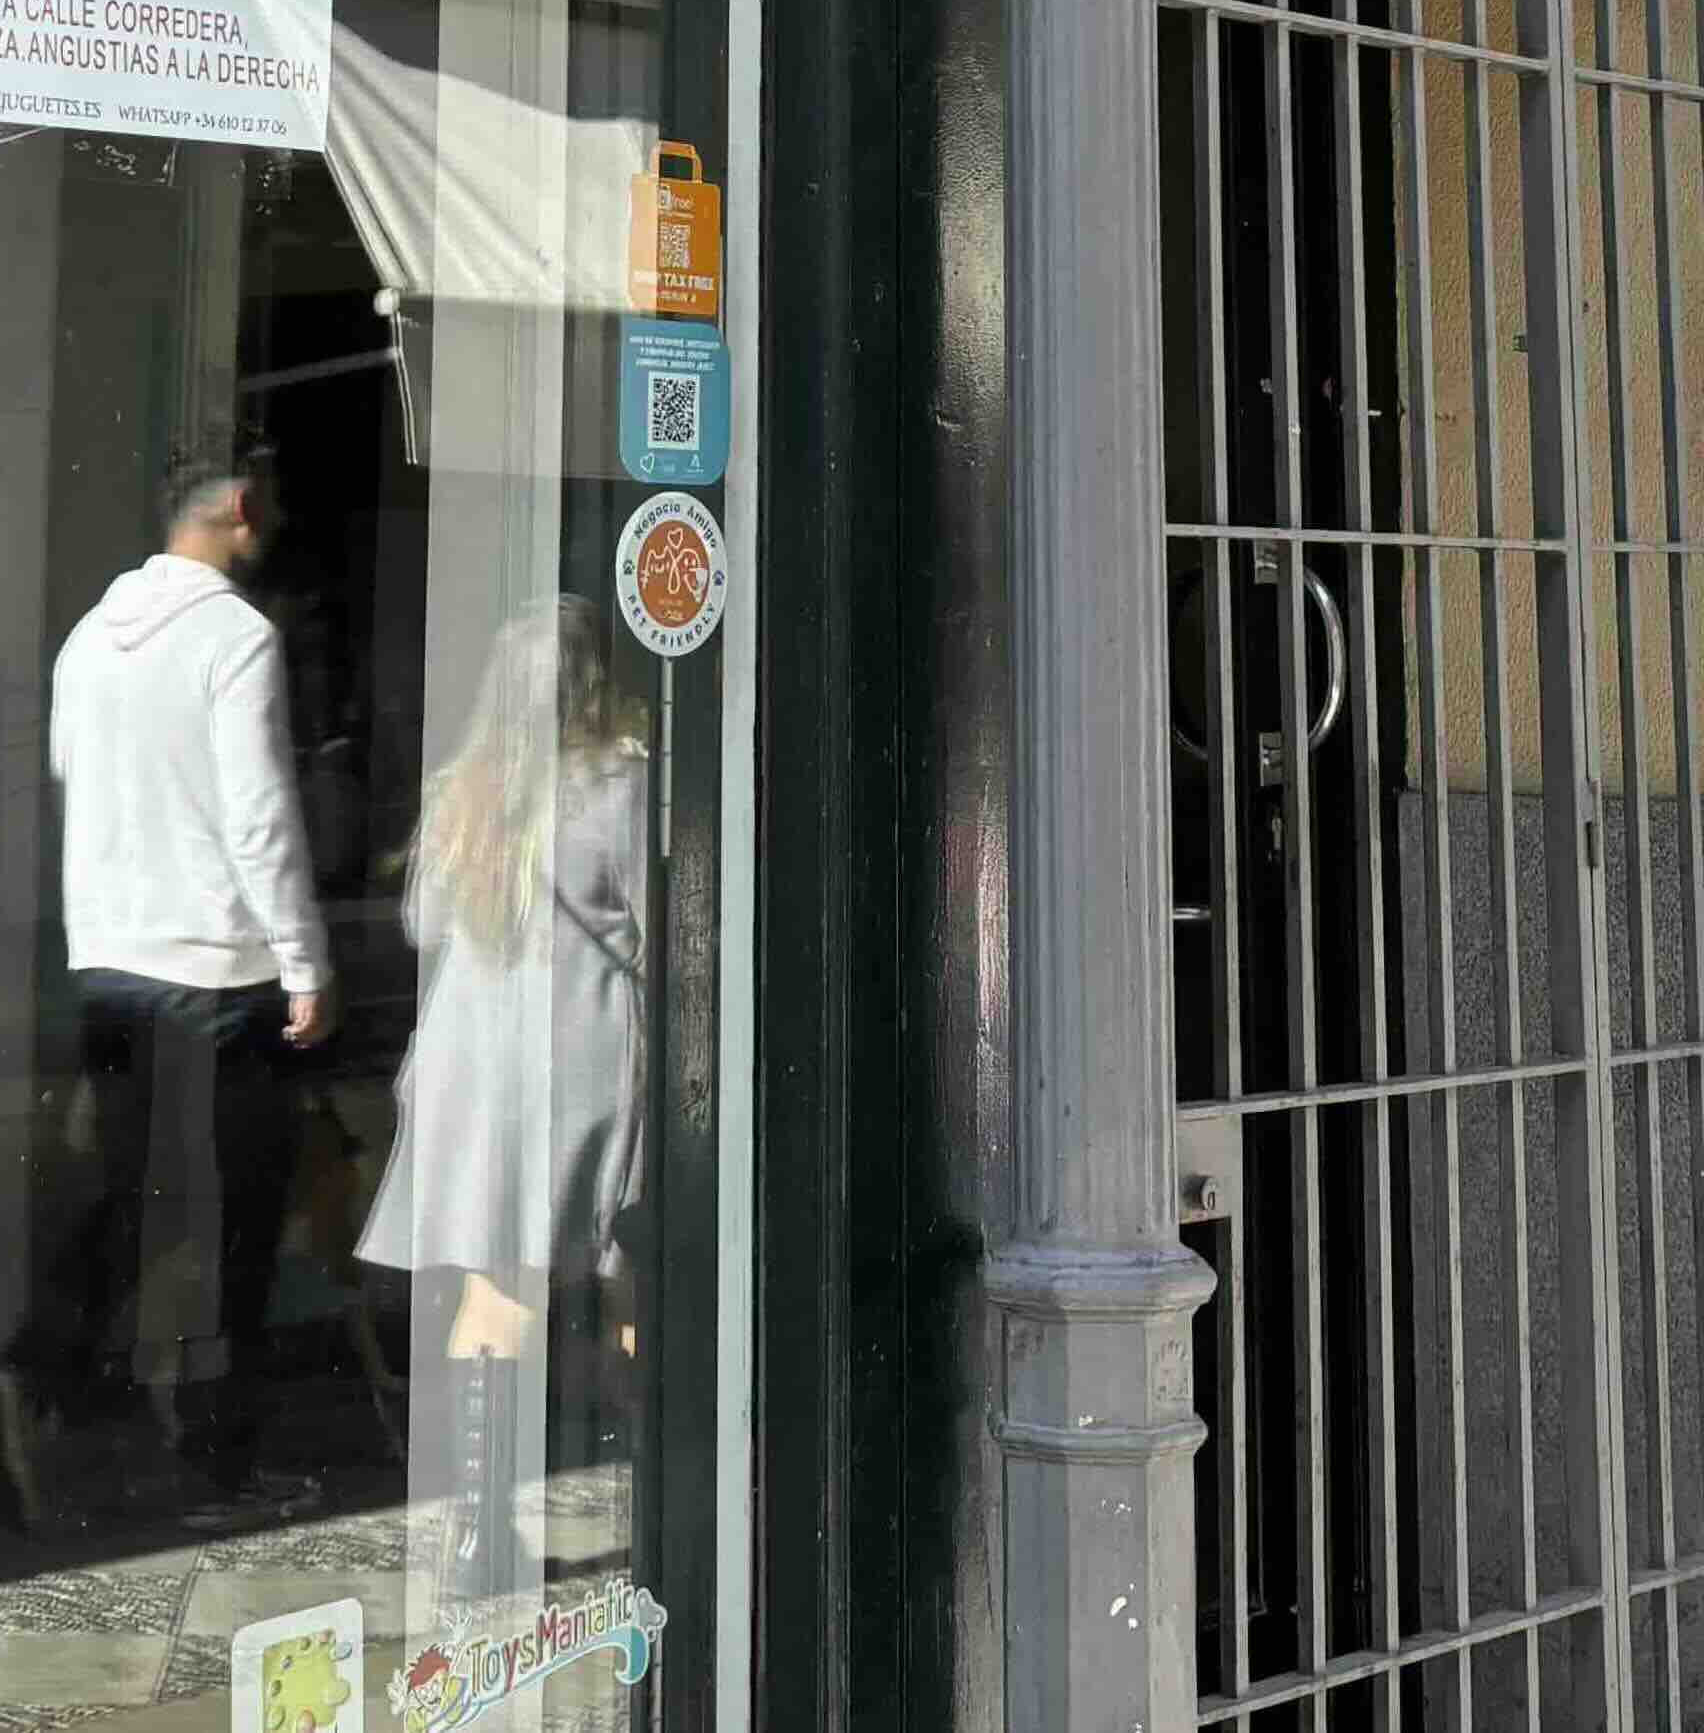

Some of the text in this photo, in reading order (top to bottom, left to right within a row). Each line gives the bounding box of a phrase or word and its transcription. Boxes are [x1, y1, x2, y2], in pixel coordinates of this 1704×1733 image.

[105, 0, 249, 51] CORREDERA,
[166, 47, 180, 79] A
[186, 50, 210, 82] LA
[218, 52, 322, 94] DERECHA
[633, 502, 717, 549] Negocio Amigo
[627, 594, 646, 627] PET
[651, 602, 715, 648] FRIENDLY
